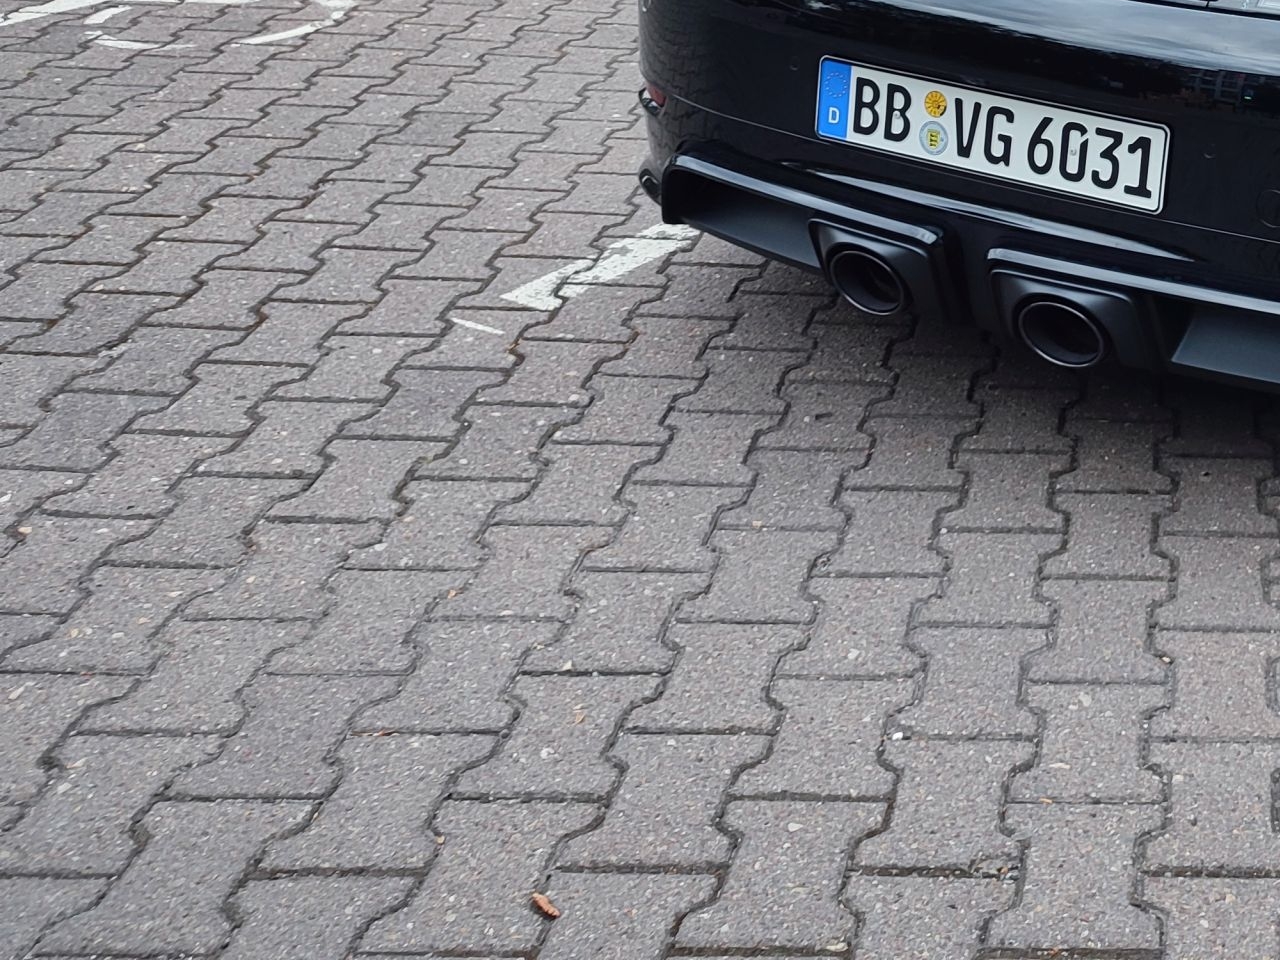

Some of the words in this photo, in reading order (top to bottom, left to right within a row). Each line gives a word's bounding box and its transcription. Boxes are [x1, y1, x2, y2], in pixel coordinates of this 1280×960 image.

[828, 107, 840, 124] D
[853, 77, 912, 142] BB
[955, 97, 1015, 167] VG
[1027, 117, 1153, 199] 6031
